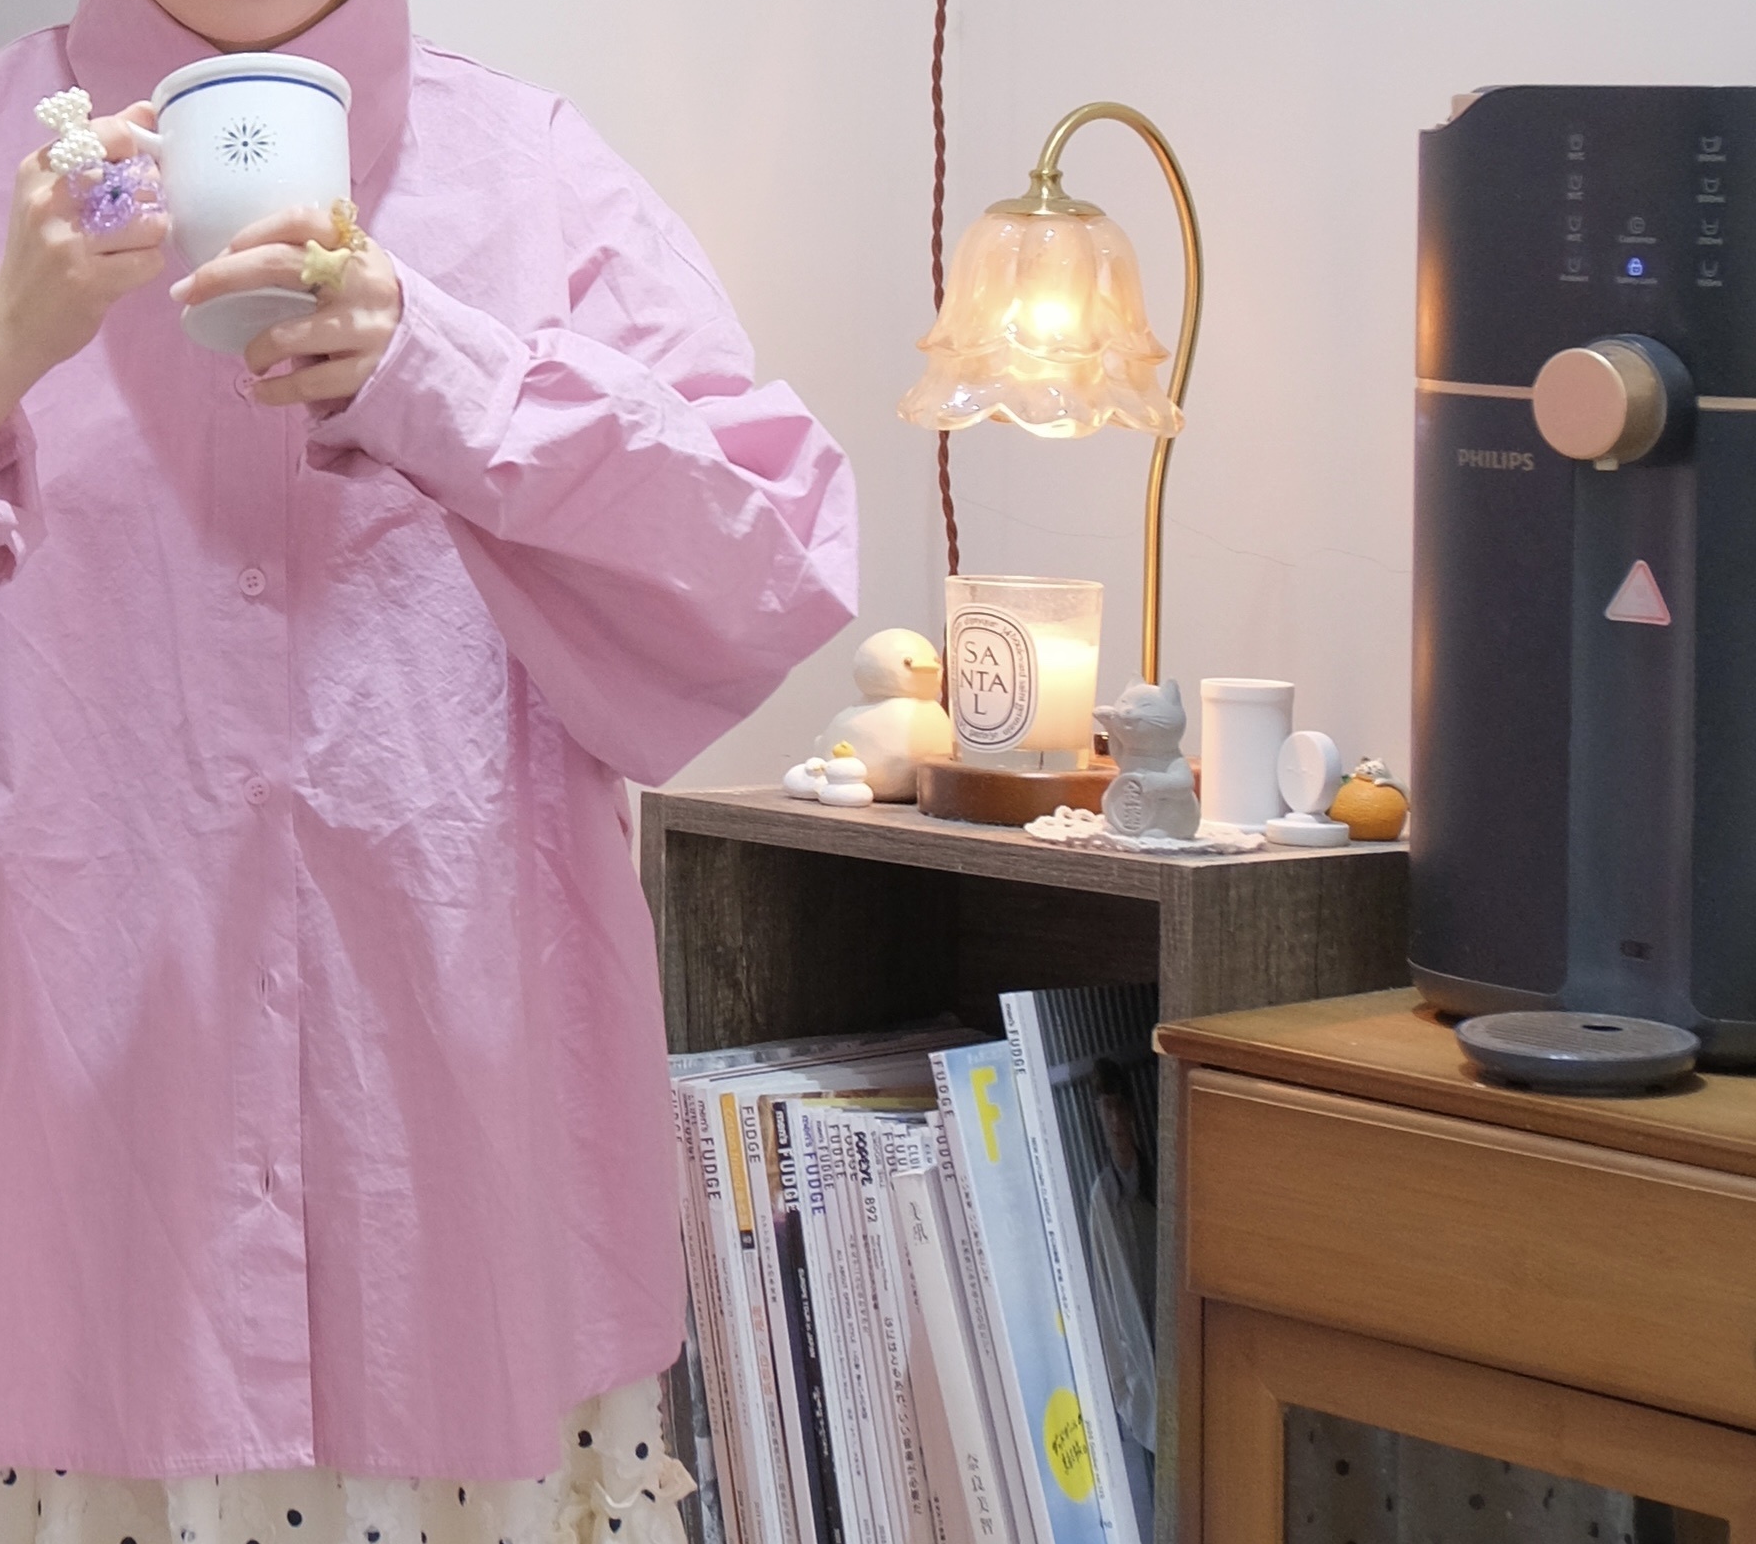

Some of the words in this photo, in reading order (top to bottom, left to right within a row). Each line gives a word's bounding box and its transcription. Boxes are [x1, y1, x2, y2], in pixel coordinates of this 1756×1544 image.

[1457, 448, 1534, 471] PHILIPS
[963, 641, 1000, 667] SA
[959, 669, 1009, 694] NTA
[973, 693, 988, 716] L
[1008, 1028, 1028, 1076] FUDGE
[932, 1059, 956, 1119] FUDGE
[697, 1100, 710, 1133] men's
[742, 1105, 762, 1164] FUDGE
[775, 1111, 790, 1145] men's
[801, 1114, 814, 1148] men's
[700, 1137, 722, 1201] FUDGE
[818, 1146, 835, 1191] FUDGE
[829, 1124, 847, 1180] FUDGE
[934, 1124, 956, 1182] FUDGE
[777, 1147, 801, 1214] FUDGE
[803, 1152, 827, 1216] FUDGE
[853, 1131, 874, 1187] POPEYE
[864, 1196, 879, 1223] 892
